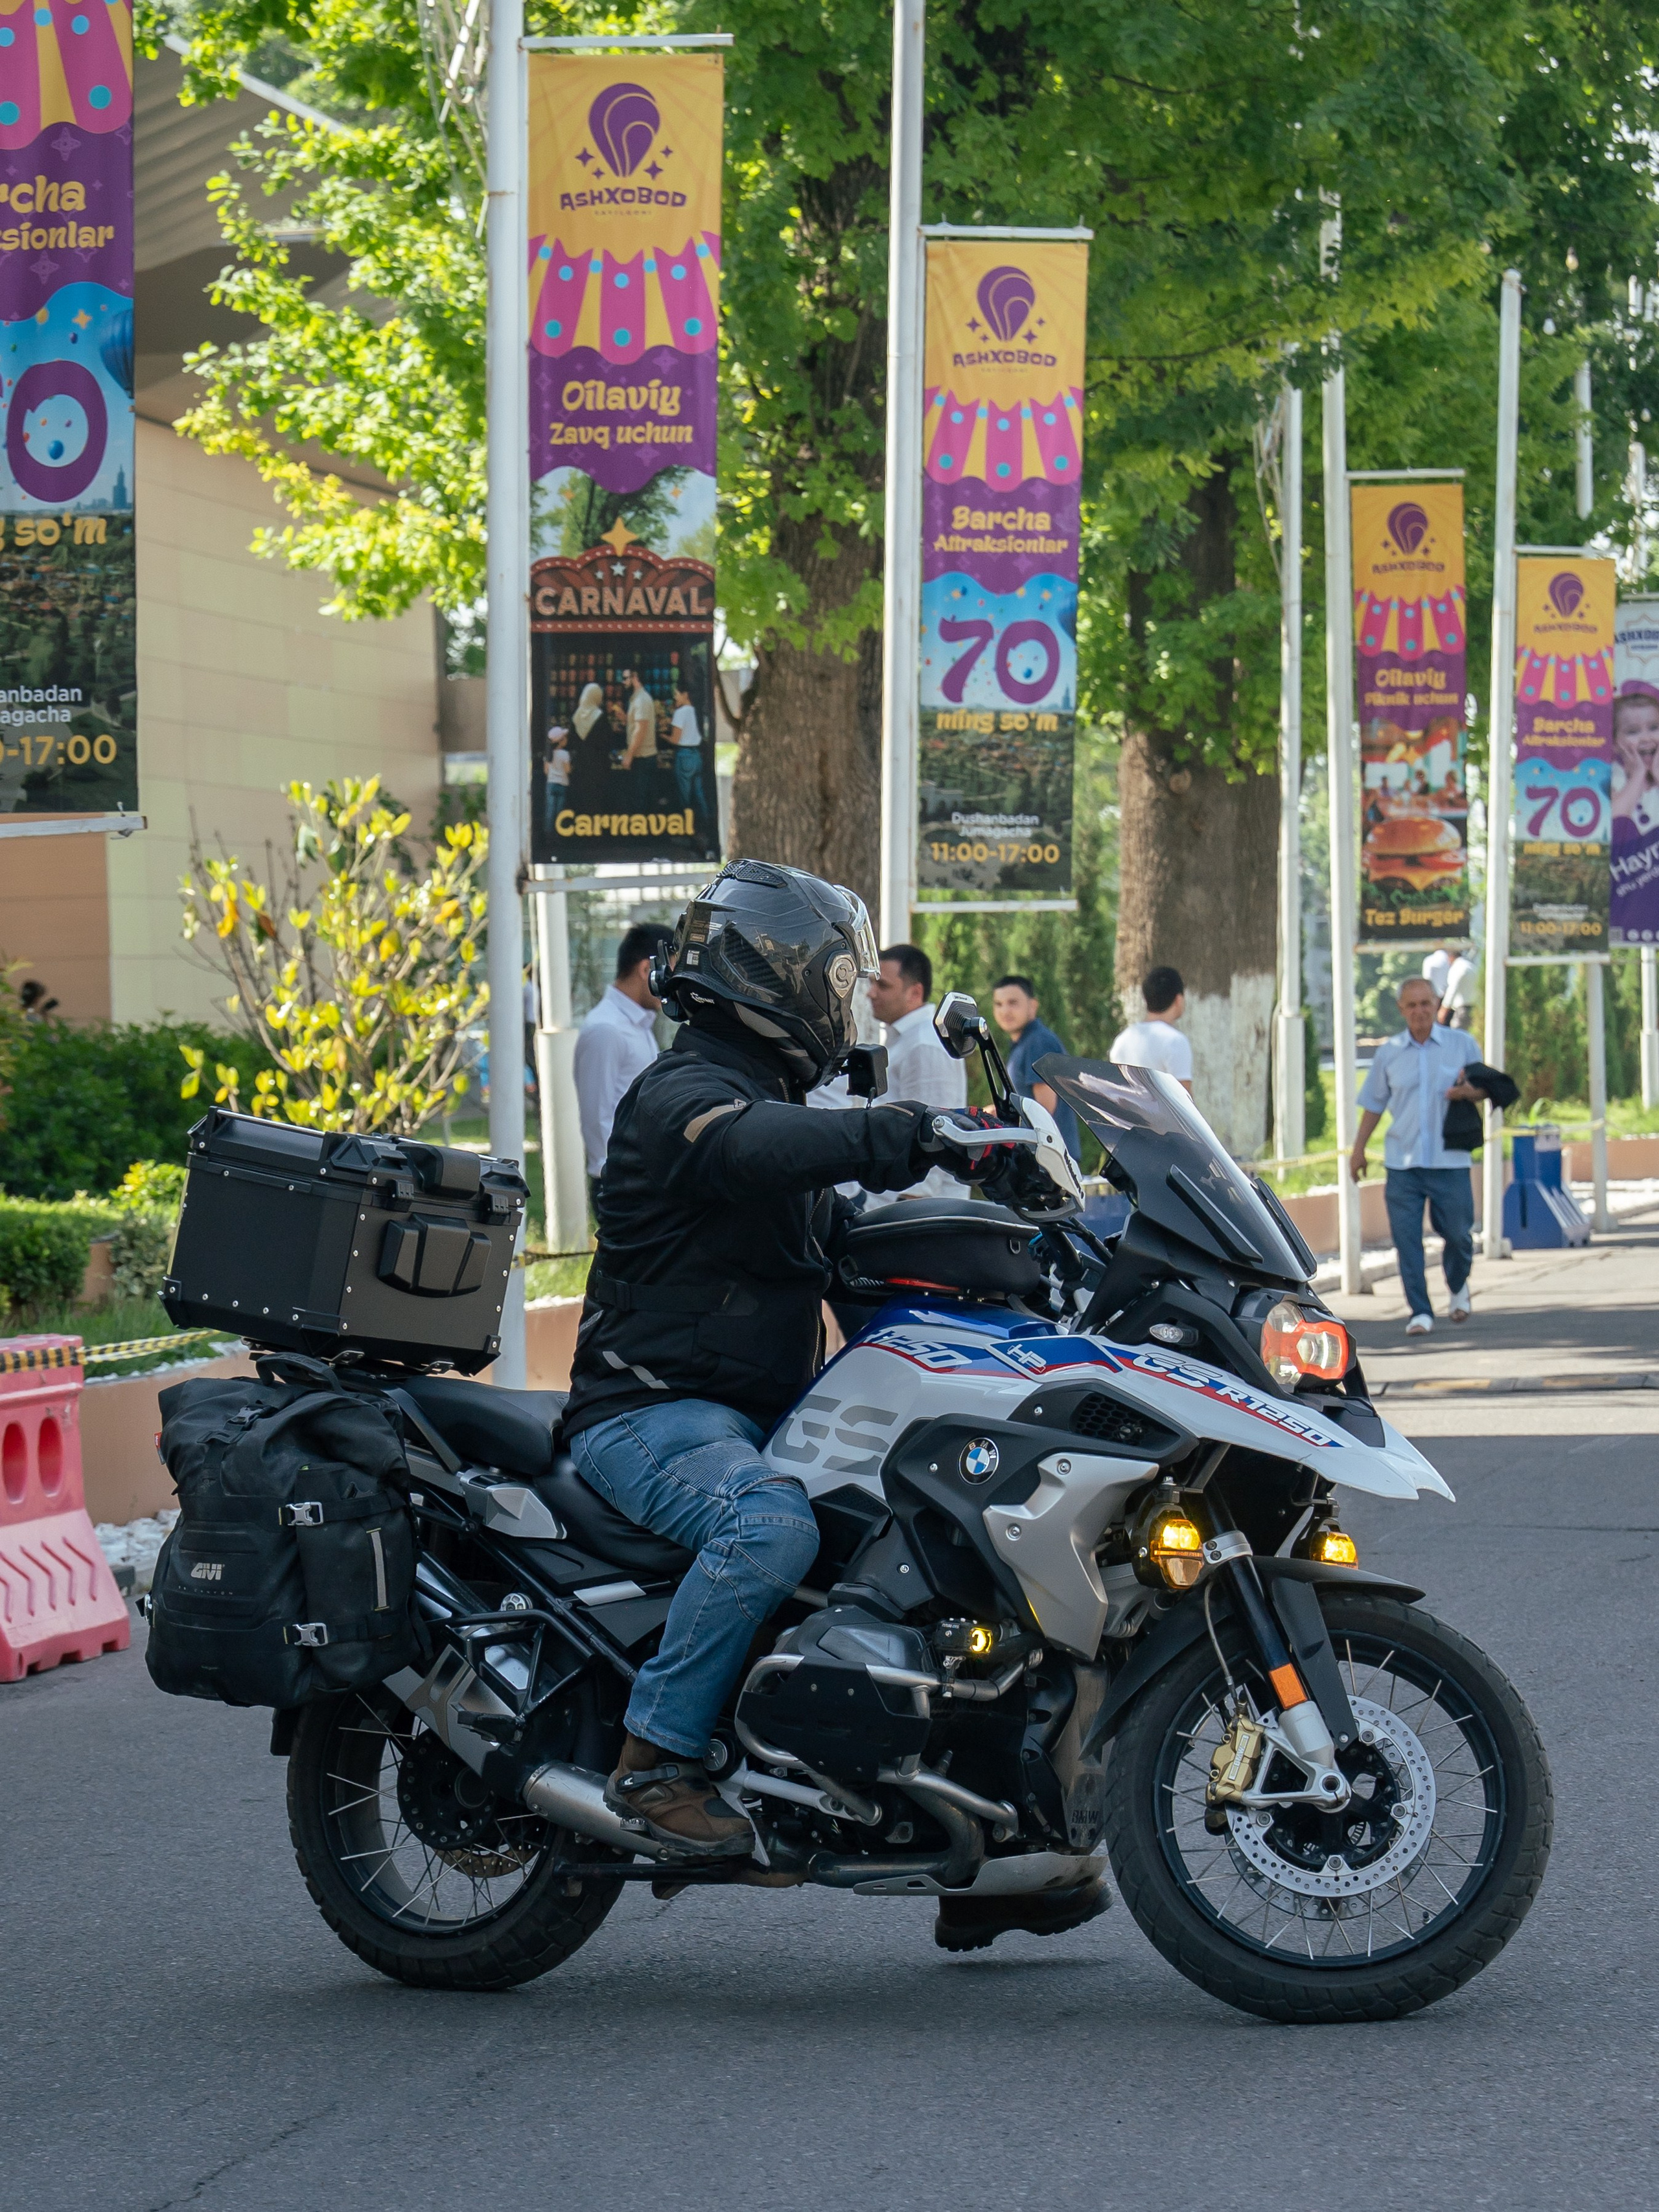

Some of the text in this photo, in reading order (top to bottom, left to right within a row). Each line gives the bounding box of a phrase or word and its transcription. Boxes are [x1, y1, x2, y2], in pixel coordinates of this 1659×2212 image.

[560, 186, 687, 211] ASHXOBOD
[0, 220, 114, 251] sionlar
[953, 350, 1057, 367] ASHXOBOD
[562, 378, 681, 417] Oilaviy
[0, 360, 108, 503] 0
[550, 421, 693, 450] Zavq uchun
[951, 506, 1052, 532] Barcha
[933, 533, 1069, 554] Attraksionlar
[535, 586, 708, 616] CARNAVAL
[938, 616, 1061, 704] 70
[936, 710, 996, 734] ming
[0, 734, 117, 765] -17:00
[555, 808, 695, 837] Carnaval
[1526, 785, 1601, 837] 70
[931, 841, 1061, 864] 11:00-17:00
[1215, 1385, 1332, 1447] R1250
[771, 1393, 899, 1477] GS
[968, 1440, 997, 1459] BMW
[191, 1562, 222, 1581] GIVI
